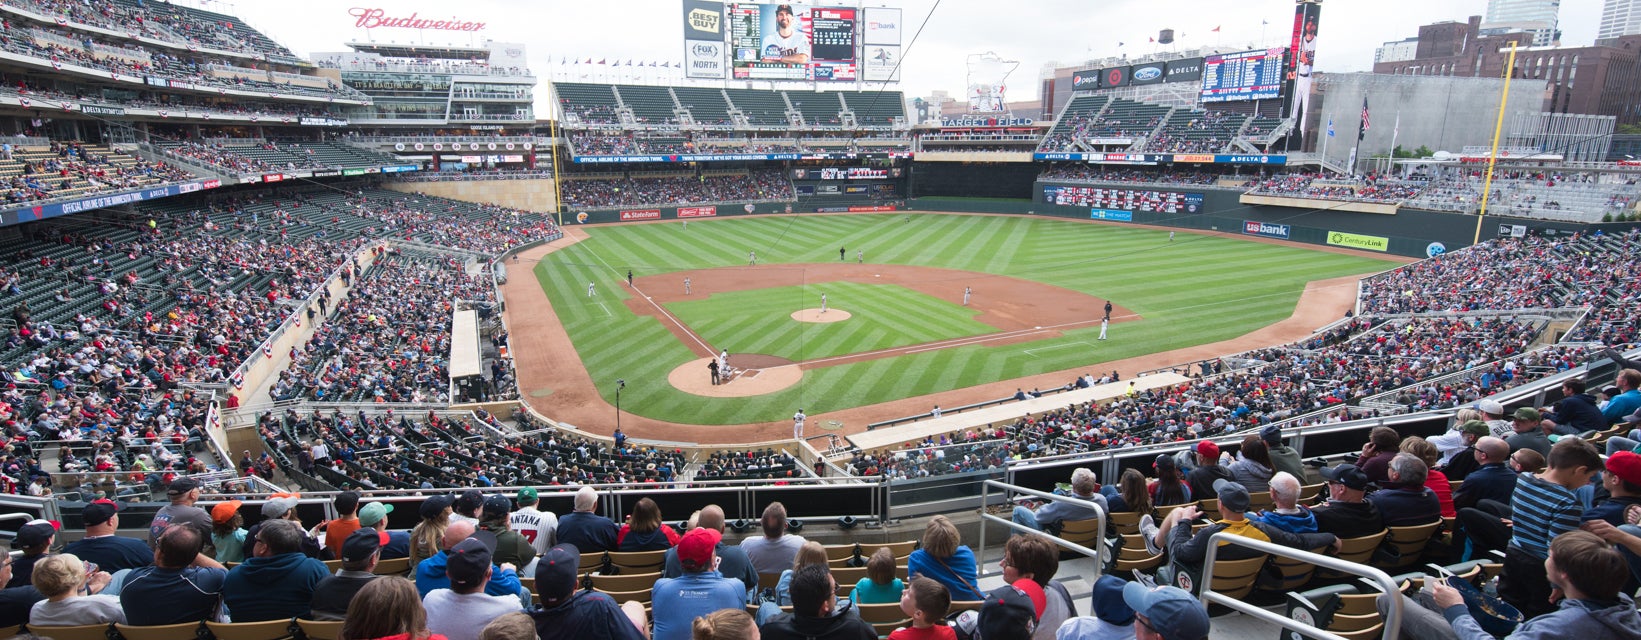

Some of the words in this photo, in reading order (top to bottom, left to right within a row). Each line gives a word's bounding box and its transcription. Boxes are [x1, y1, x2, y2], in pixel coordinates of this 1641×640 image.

[348, 7, 486, 31] Budweiser
[692, 12, 718, 22] BEST
[694, 20, 716, 28] BUY
[697, 45, 713, 53] FOX
[693, 60, 718, 69] NORTH
[1176, 66, 1199, 74] DELTA
[1082, 76, 1098, 84] pepsi
[942, 119, 986, 127] TARGET
[998, 118, 1032, 126] FIELD
[62, 202, 82, 214] OFFICIAL
[1344, 236, 1382, 248] CenturyLink
